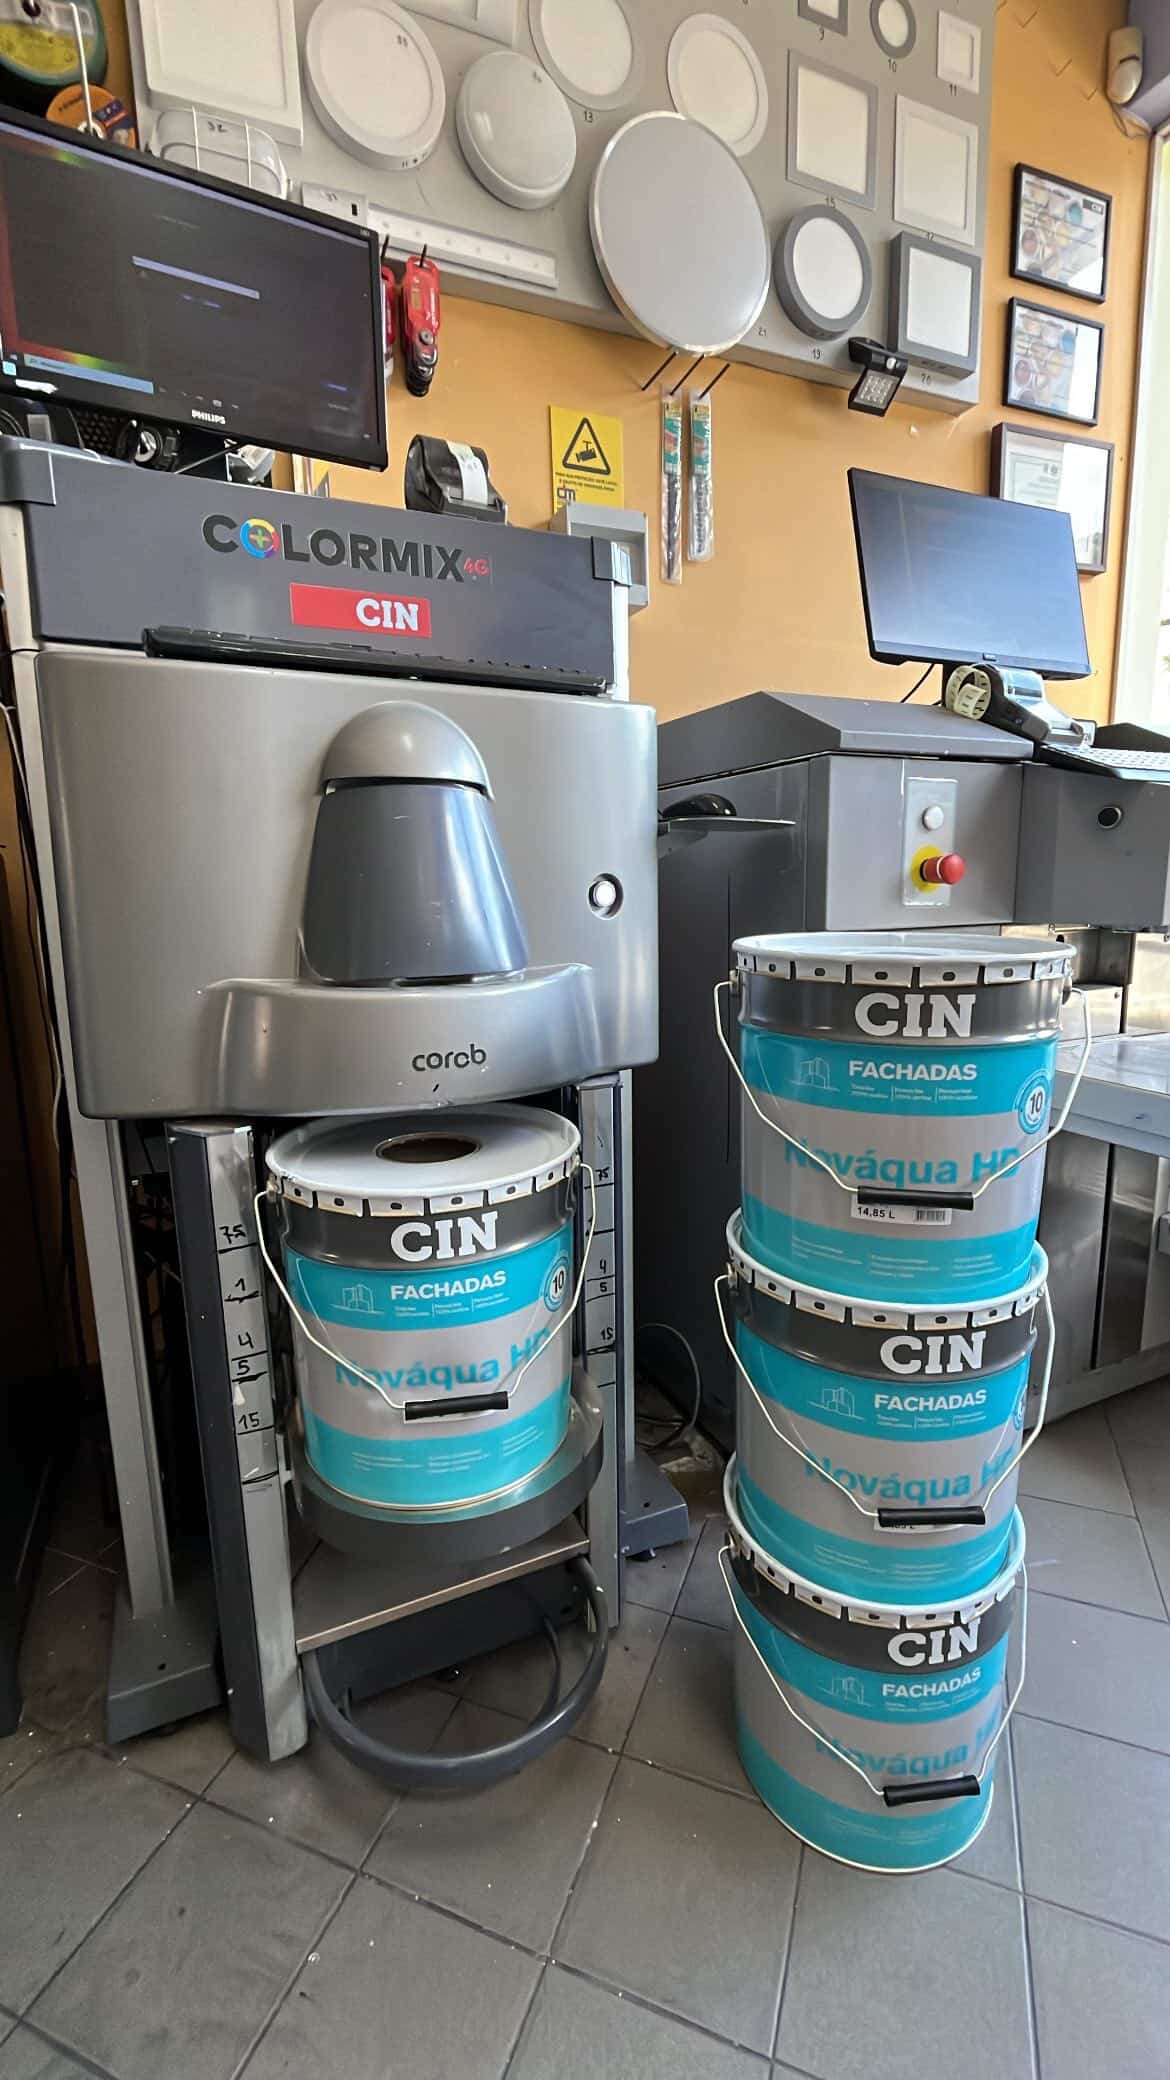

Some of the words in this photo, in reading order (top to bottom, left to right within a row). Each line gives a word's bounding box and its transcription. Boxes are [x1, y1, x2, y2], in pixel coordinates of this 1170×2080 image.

[887, 58, 897, 73] 10
[949, 83, 958, 97] 11
[826, 196, 836, 209] 15
[812, 349, 821, 360] 19
[192, 409, 226, 425] PHILIPS
[202, 514, 464, 583] COLORMIX
[463, 557, 490, 577] 4G
[356, 597, 419, 632] CIN
[855, 992, 977, 1038] CIN
[848, 1060, 978, 1081] FACHADAS
[1030, 1090, 1043, 1114] 10
[785, 1140, 958, 1188] Nováqua
[971, 1147, 1021, 1181] HD
[594, 1167, 610, 1182] 75
[888, 1208, 896, 1219] L
[219, 1224, 246, 1244] 75
[390, 1211, 498, 1262] CIN
[599, 1258, 607, 1275] 4
[235, 1277, 246, 1291] 1
[391, 1270, 507, 1300] FACHADAS
[552, 1269, 565, 1292] 10
[600, 1281, 608, 1293] 5
[238, 1331, 254, 1349] 4
[880, 1331, 987, 1375] CIN
[237, 1359, 250, 1376] 5
[874, 1389, 987, 1412] FACHADAS
[238, 1411, 260, 1430] 15
[888, 1616, 980, 1667] CIN
[882, 1666, 981, 1698] FACHADAS
